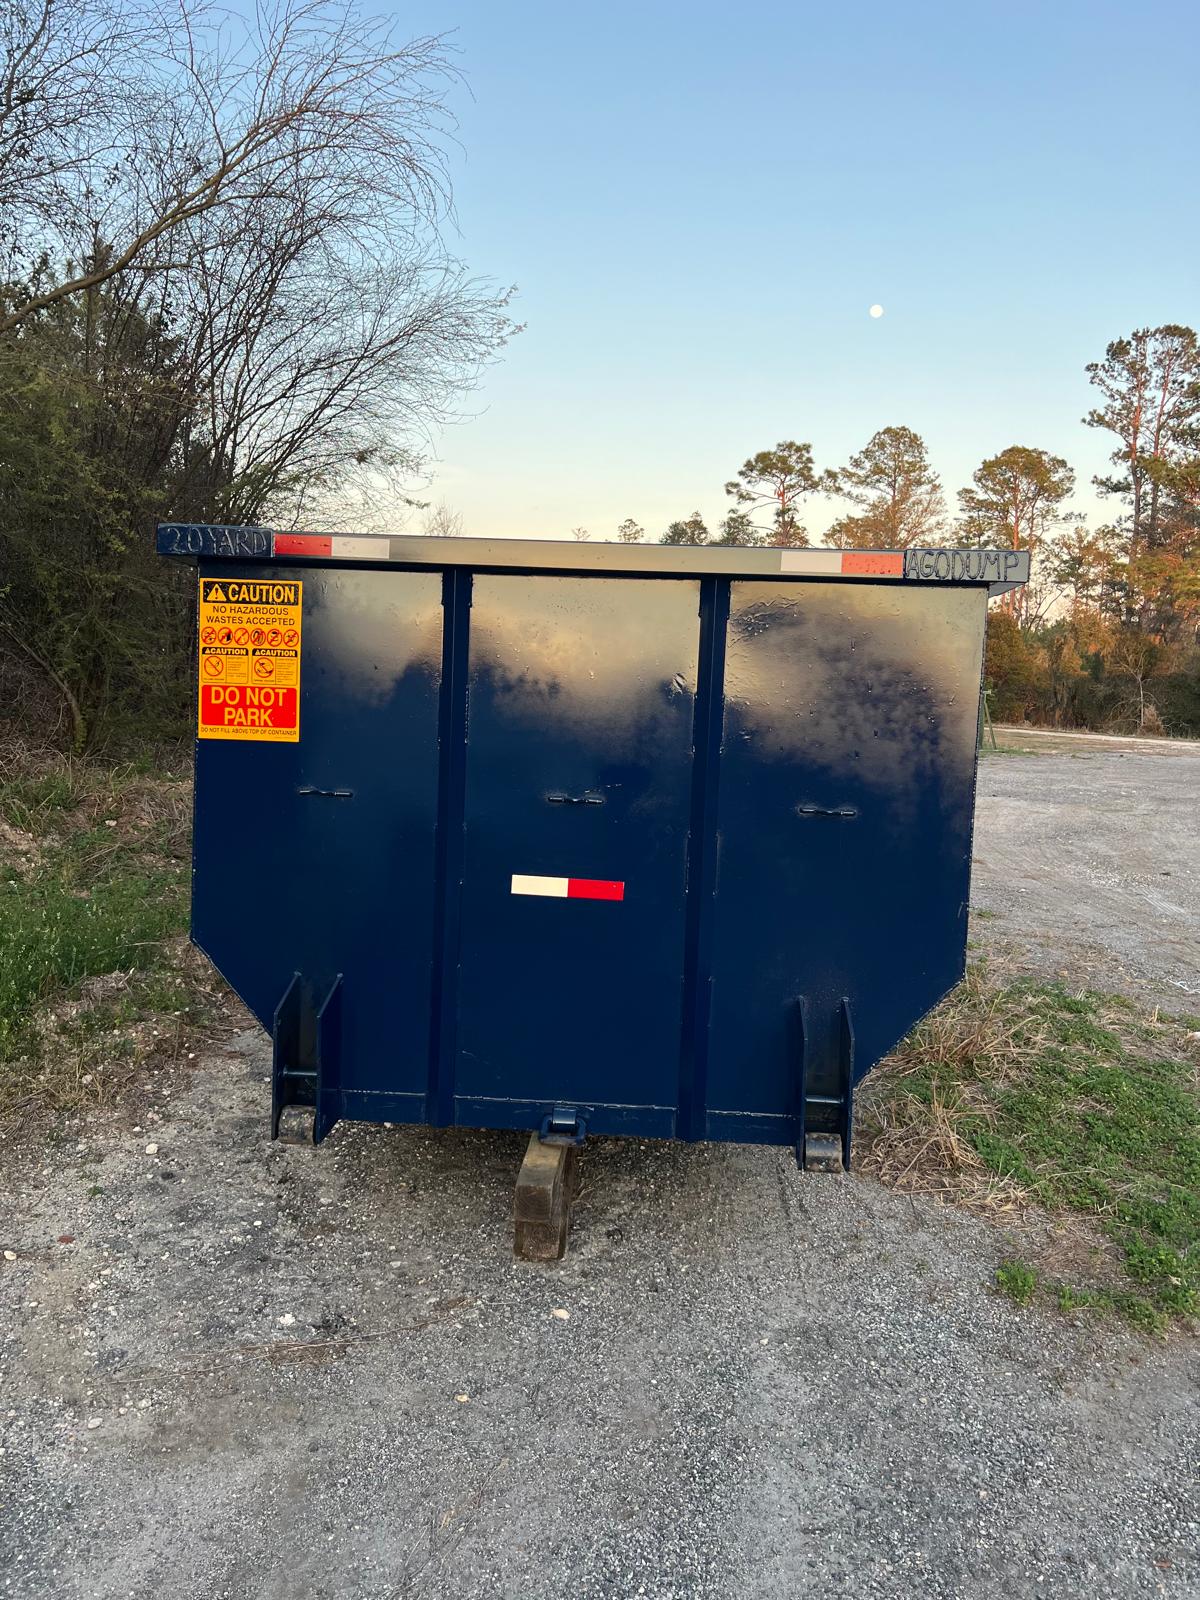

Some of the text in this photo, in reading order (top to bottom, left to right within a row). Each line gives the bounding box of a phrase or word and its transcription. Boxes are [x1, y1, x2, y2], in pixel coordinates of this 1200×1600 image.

[167, 528, 267, 556] 20 YARD
[228, 584, 295, 603] CAUTION
[212, 606, 288, 615] NO HAZARDOUS
[206, 616, 294, 626] WASTES ACCEPTED
[211, 686, 287, 706] DO NOT
[224, 707, 273, 726] PARK
